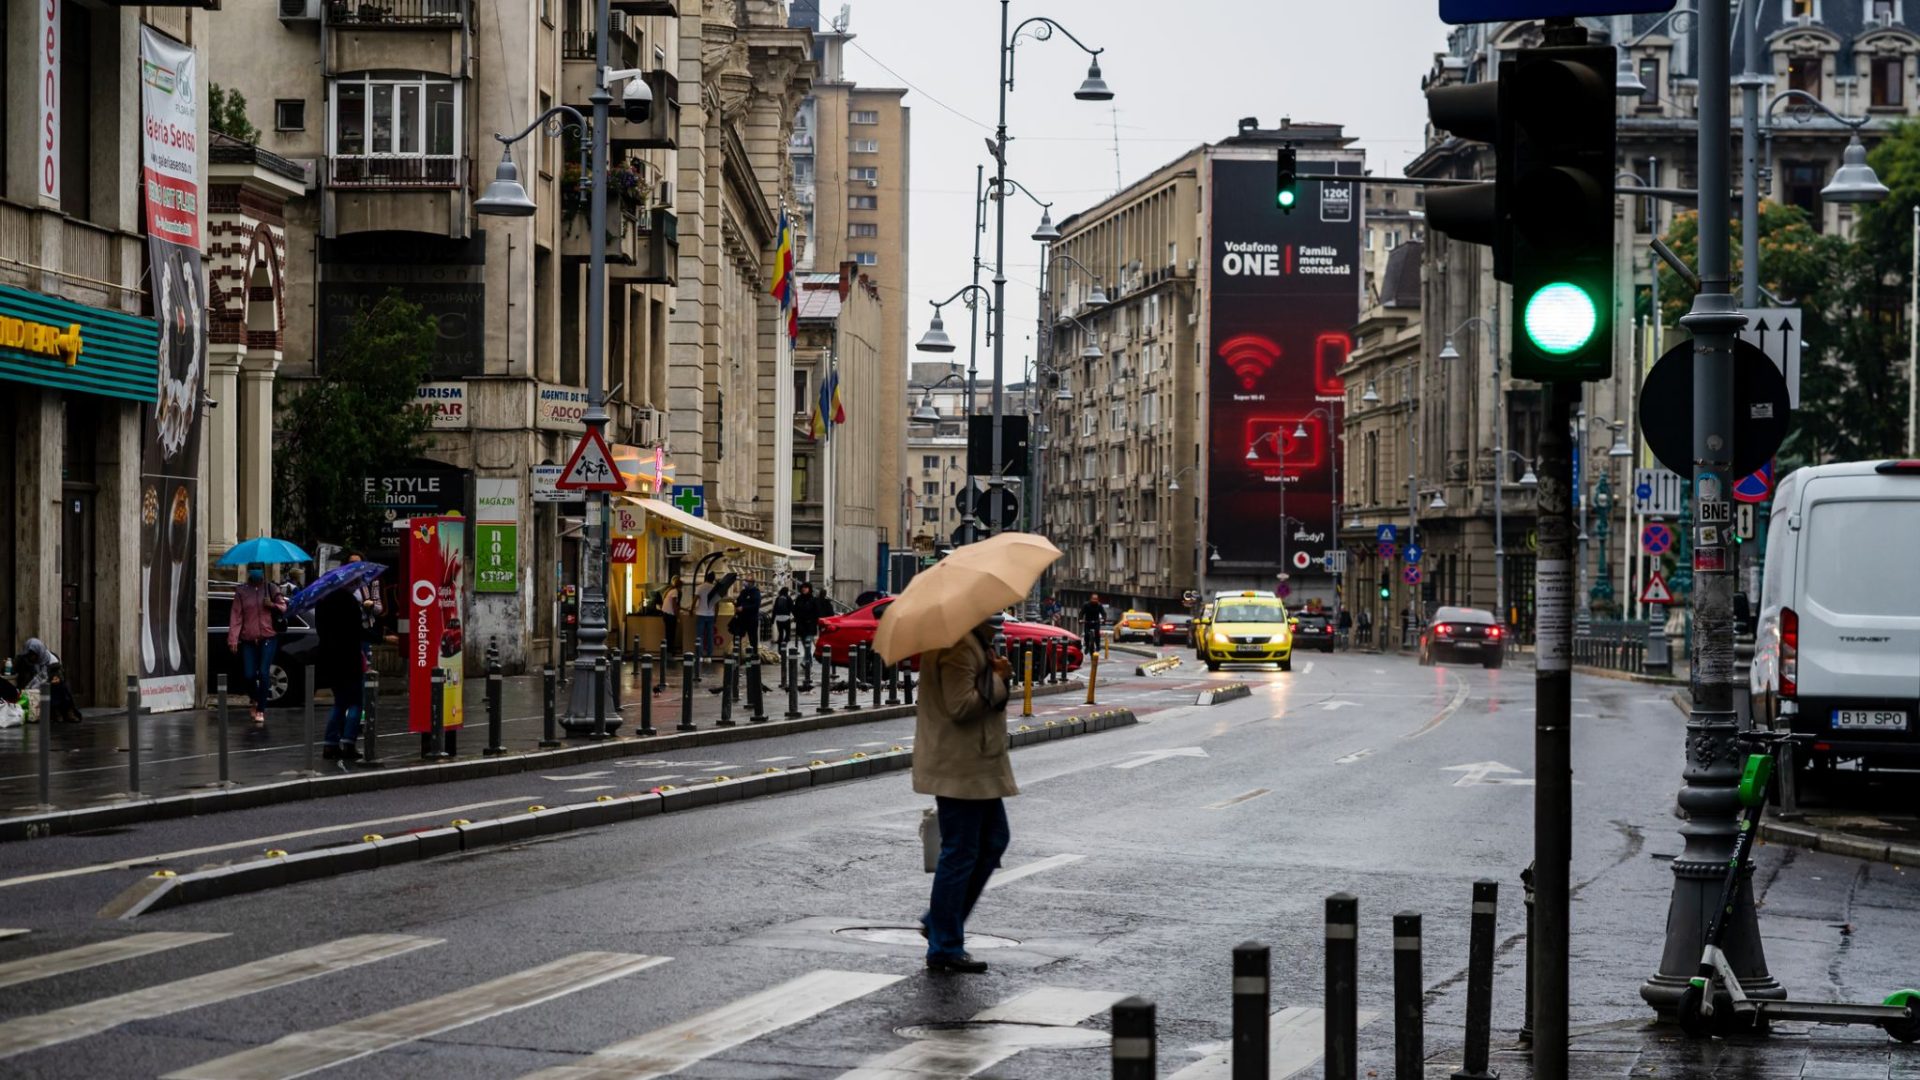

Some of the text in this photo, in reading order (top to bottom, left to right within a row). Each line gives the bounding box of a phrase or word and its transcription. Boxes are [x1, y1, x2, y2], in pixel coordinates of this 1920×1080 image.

[170, 123, 196, 153] Senso
[1323, 188, 1349, 198] 120€
[1224, 241, 1278, 253] Vodafone
[1299, 246, 1338, 256] Familia
[1222, 253, 1280, 276] ONE
[1299, 257, 1333, 265] mereu
[1299, 264, 1351, 275] conectată
[420, 292, 481, 304] COMPANY
[24, 321, 60, 355] BAR
[417, 388, 462, 399] URISM
[570, 392, 579, 402] DE
[401, 402, 463, 416] OMAR
[364, 477, 440, 492] E STYLE
[364, 491, 417, 504] fhion
[479, 497, 515, 506] MAGAZIN
[619, 510, 632, 521] To
[1702, 504, 1728, 520] BNE
[621, 519, 636, 532] go
[1294, 532, 1325, 543] Rdy?
[491, 530, 502, 566] non
[613, 542, 636, 561] illy
[418, 609, 430, 668] vodafone
[1841, 712, 1902, 725] B 13 SPO
